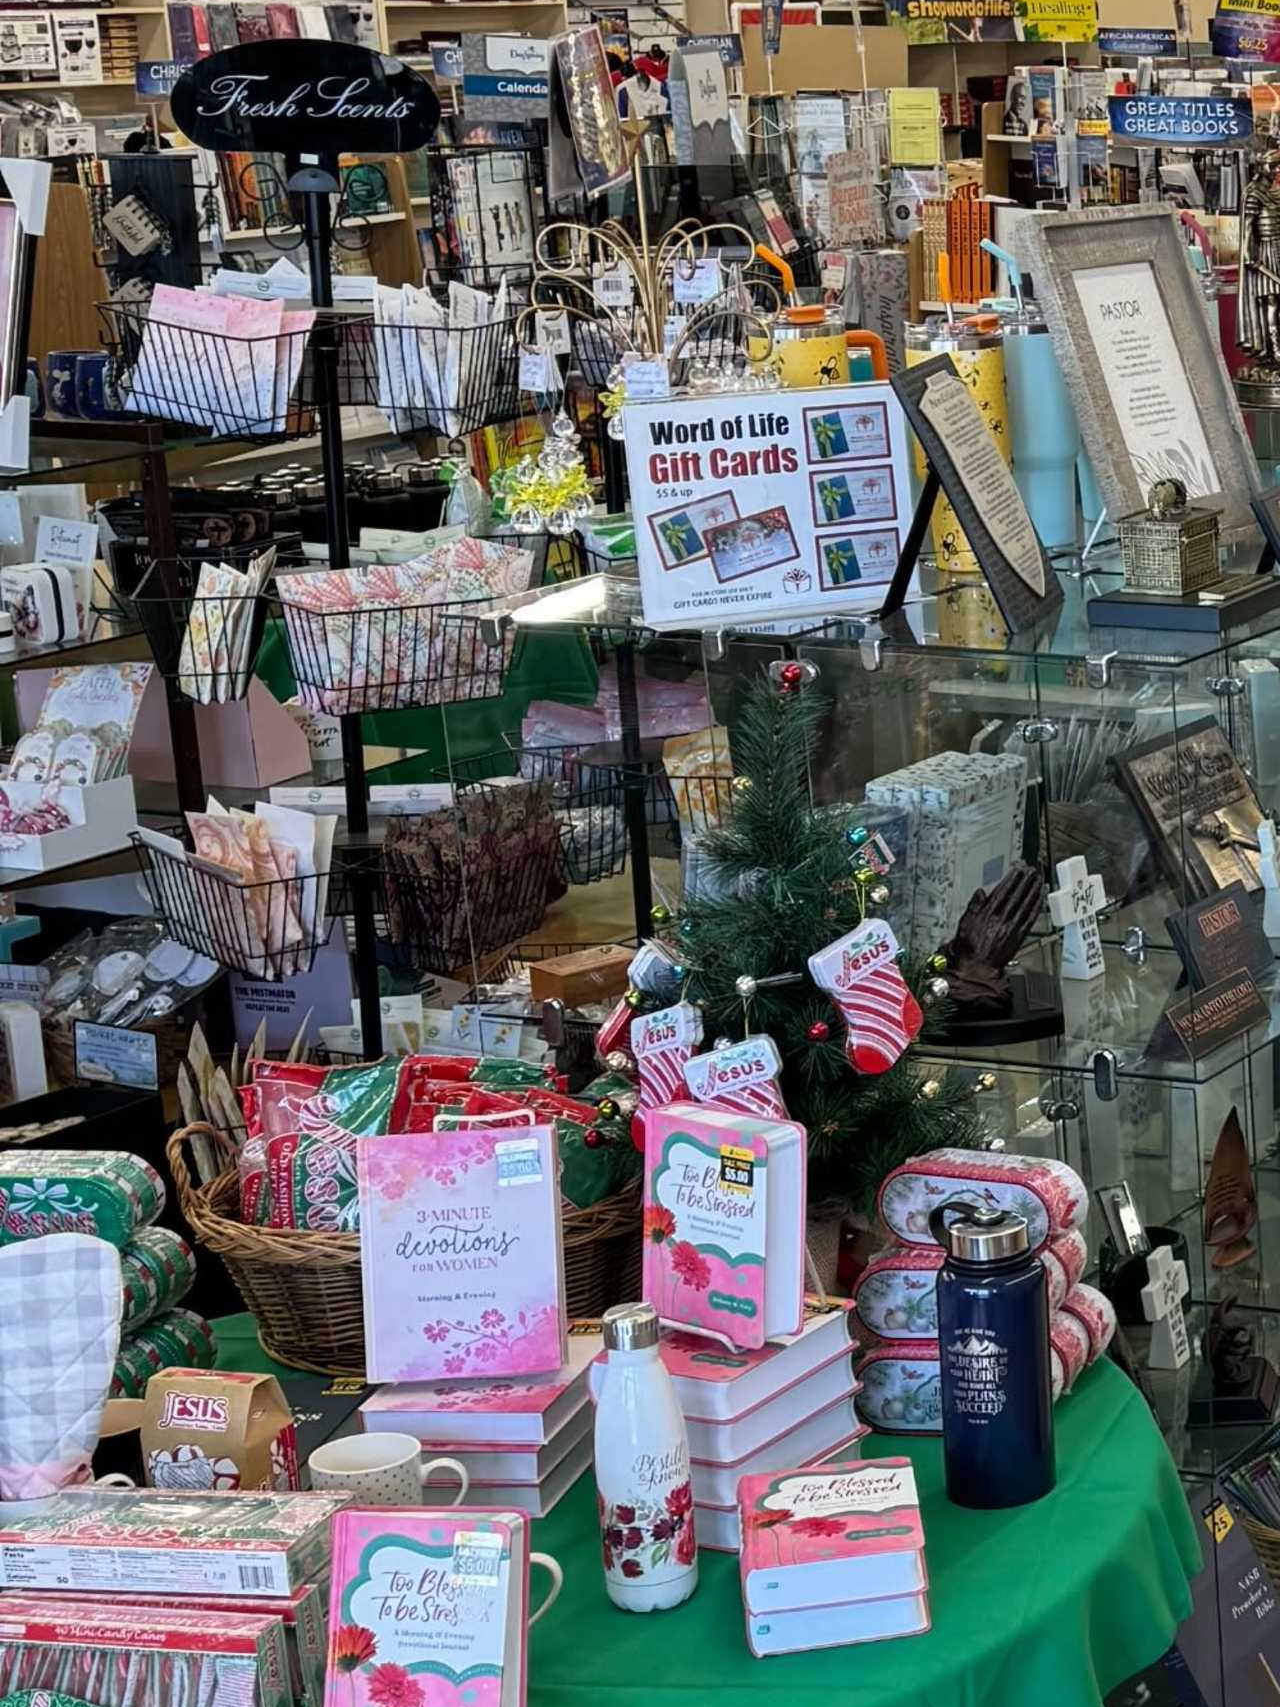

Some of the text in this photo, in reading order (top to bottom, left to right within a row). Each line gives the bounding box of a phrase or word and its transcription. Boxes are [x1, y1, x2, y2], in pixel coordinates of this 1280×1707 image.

[1032, 2, 1086, 16] Healing
[197, 74, 416, 119] Fresh Scents
[1125, 102, 1235, 117] GREAT TITLES
[1125, 119, 1239, 135] GREAT BOOKS
[1100, 300, 1143, 320] PASTOR
[650, 413, 789, 445] Word of Life
[650, 445, 798, 484] Gift Cards
[656, 488, 693, 499] $5 up
[746, 591, 772, 602] EXPIRE
[1200, 900, 1241, 936] PASTOR
[696, 1058, 765, 1095] Jesus
[725, 1169, 748, 1183] $5.00
[705, 1189, 756, 1219] Stressed
[396, 1223, 521, 1260] devotions
[412, 1257, 498, 1273] FOR WOMEN
[160, 1390, 229, 1427] JESUS
[829, 1473, 896, 1491] Blessed
[835, 1482, 901, 1499] Stressed
[383, 1570, 413, 1593] Too
[371, 1594, 419, 1621] To be
[55, 1626, 166, 1642] 40 Candy Canes
